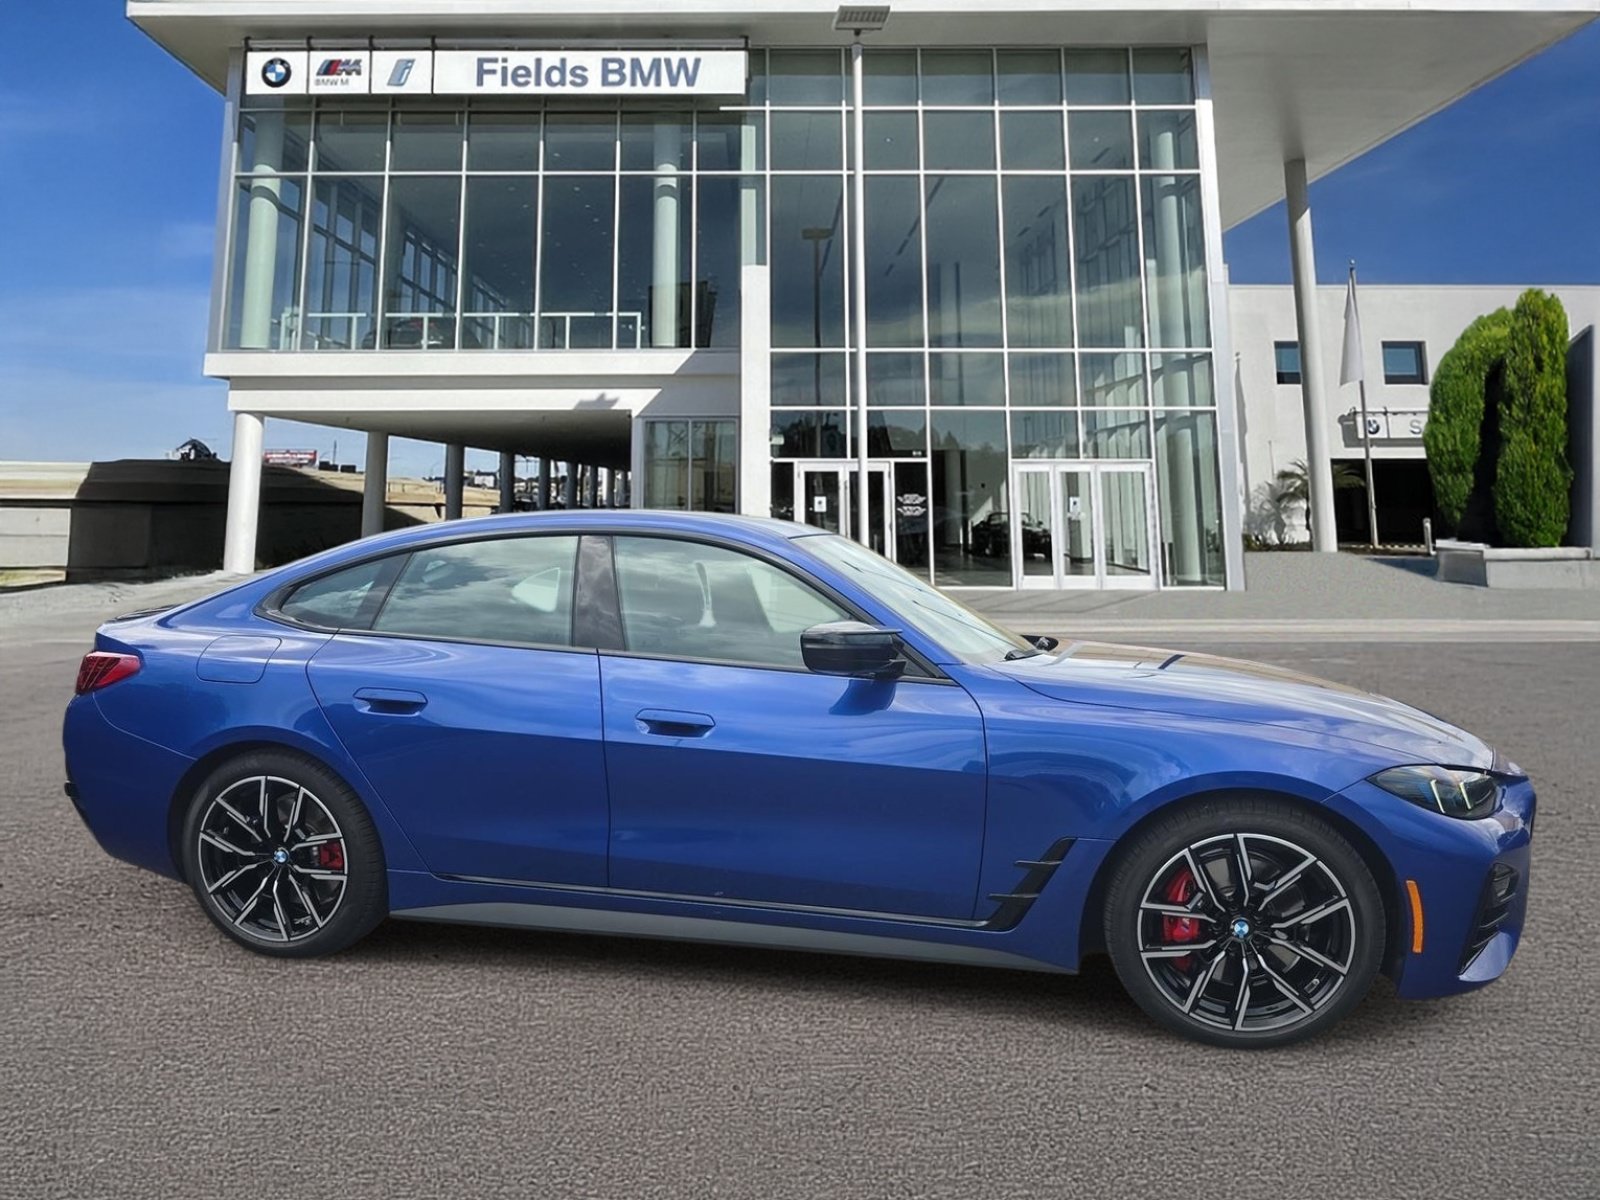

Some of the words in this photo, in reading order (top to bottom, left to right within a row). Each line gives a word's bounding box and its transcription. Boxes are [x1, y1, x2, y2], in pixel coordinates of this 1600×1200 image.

[314, 78, 338, 86] BMW
[476, 57, 589, 88] Fields
[601, 57, 702, 88] BMW
